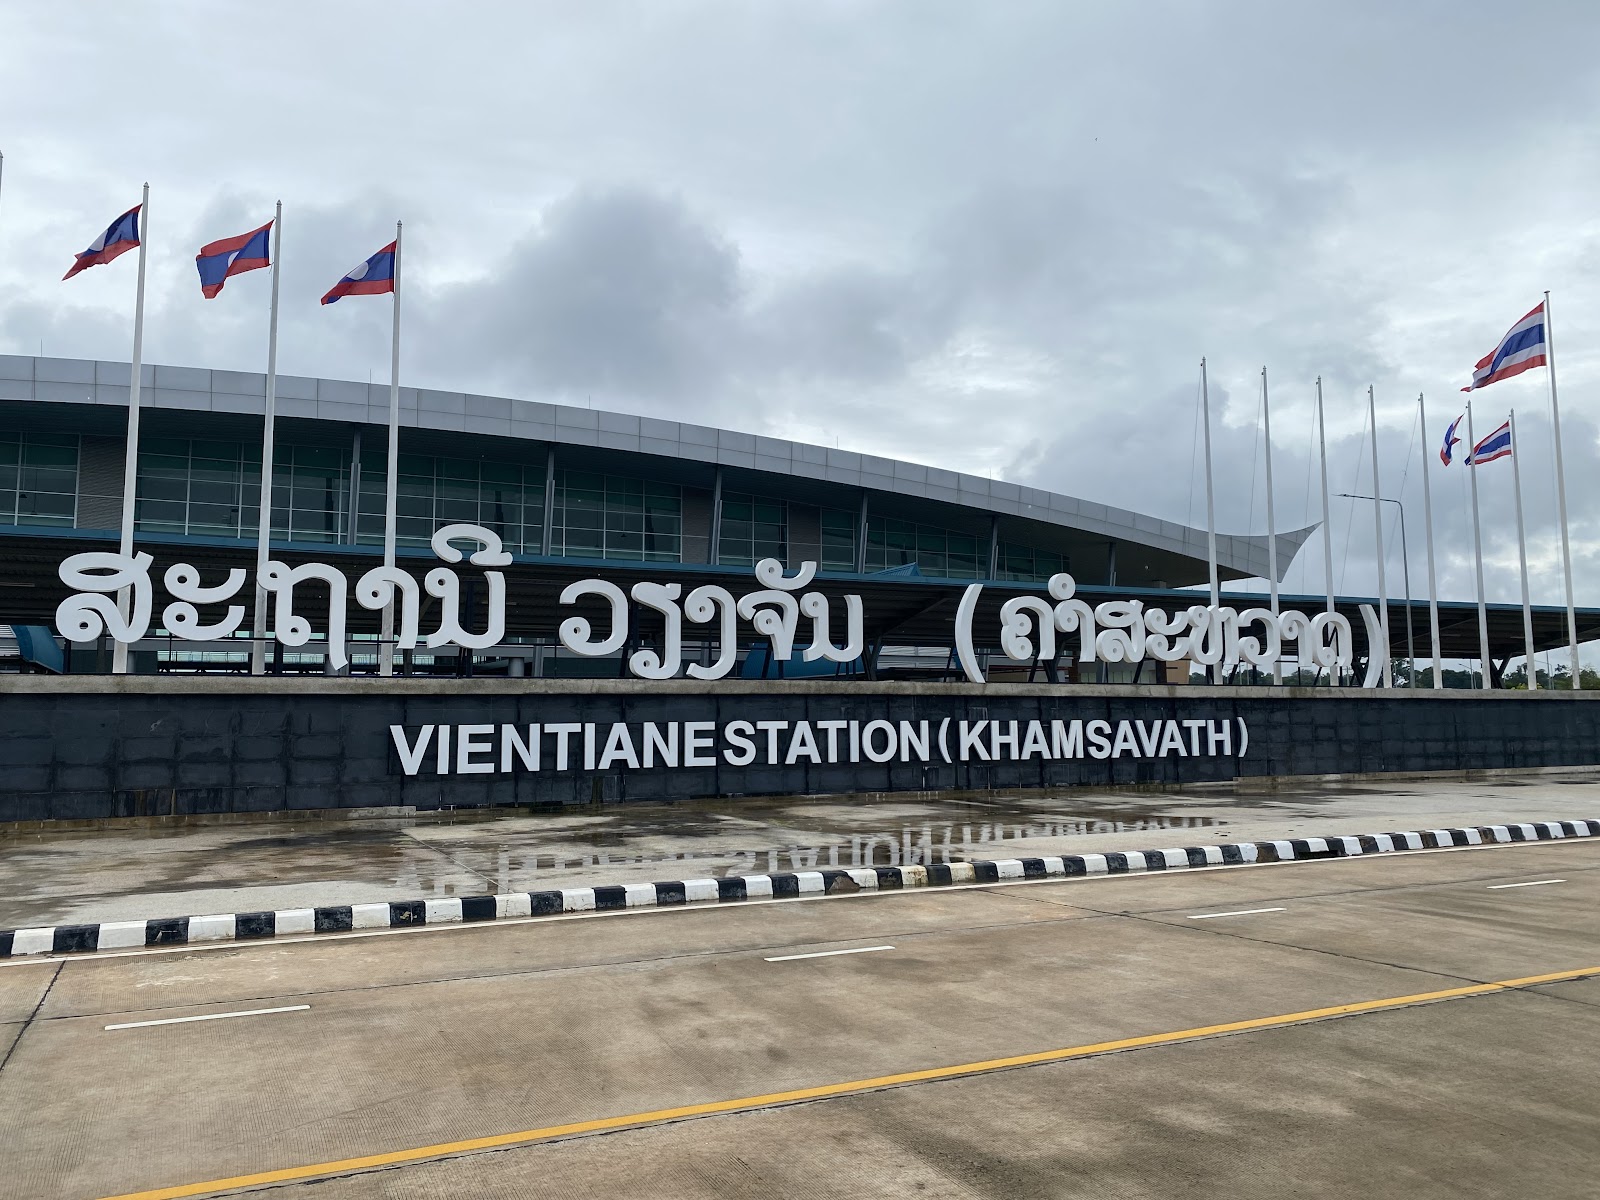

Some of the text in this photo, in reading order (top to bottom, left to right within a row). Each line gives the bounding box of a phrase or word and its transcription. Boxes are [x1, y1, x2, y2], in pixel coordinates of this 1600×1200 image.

[55, 523, 513, 670] ສະຖານີ
[559, 557, 864, 680] ວຽງຈັນ
[938, 716, 1249, 764] (KHAMSAVATH)
